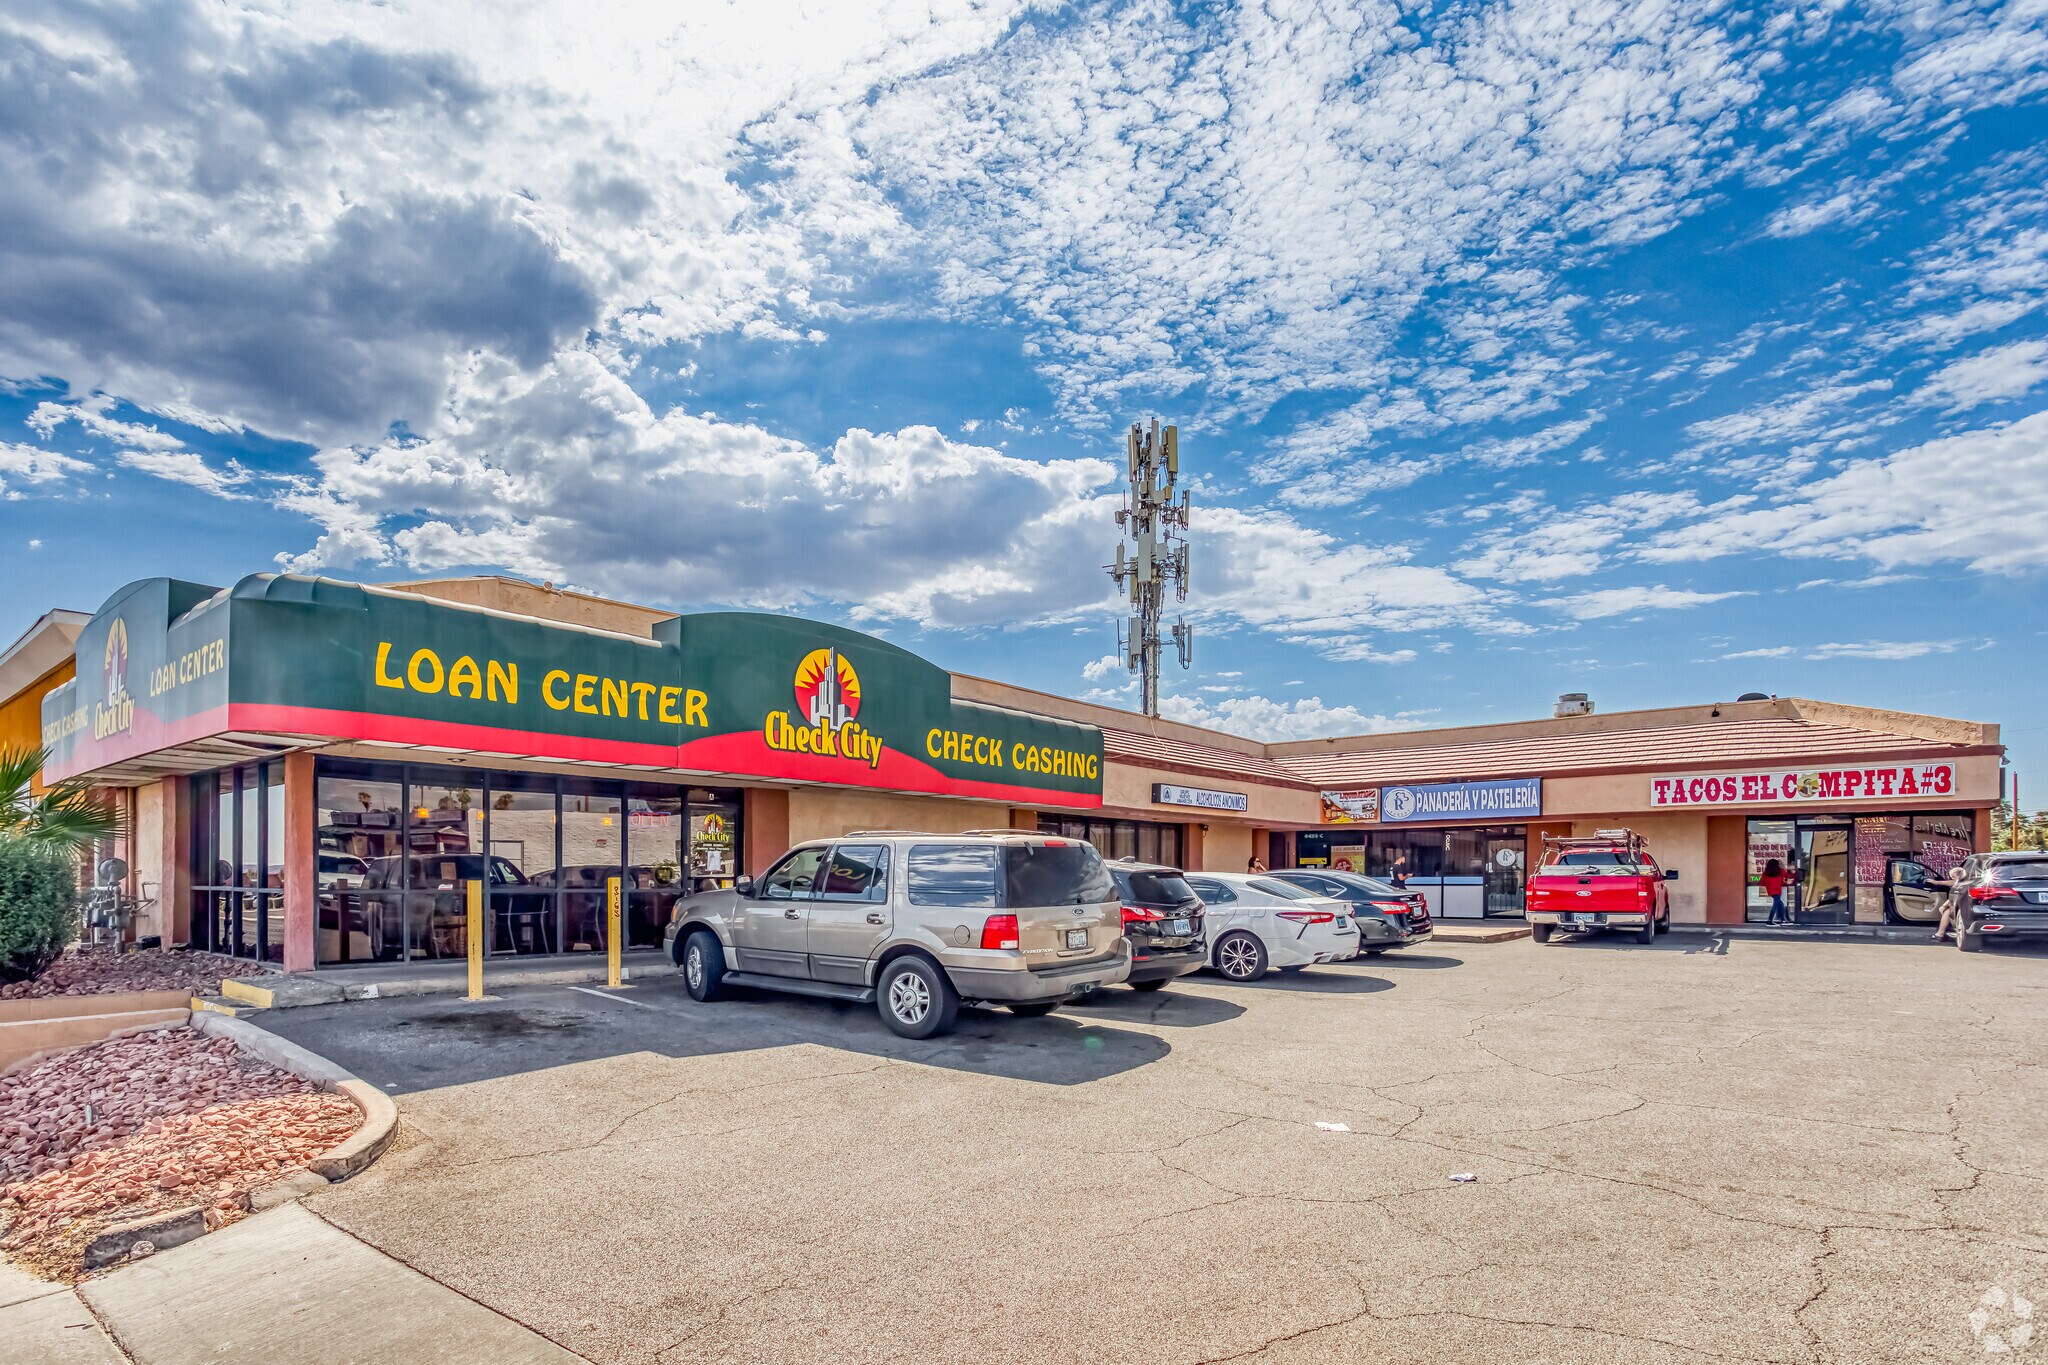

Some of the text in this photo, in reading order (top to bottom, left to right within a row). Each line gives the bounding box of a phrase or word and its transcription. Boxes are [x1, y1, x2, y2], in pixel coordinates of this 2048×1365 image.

[150, 638, 224, 698] LOAN CENTER
[375, 641, 709, 728] LOAN CENTER
[94, 689, 135, 741] Check City
[763, 709, 884, 769] Check City
[926, 728, 1098, 780] CHECK CASHING
[1416, 781, 1538, 813] PANADERÍA Y PASTELERÍA
[1654, 776, 1738, 804] TACOS
[1741, 775, 1778, 801] EL
[1781, 767, 1919, 800] CMPITA
[630, 811, 670, 828] OPEN
[696, 830, 730, 843] Check City
